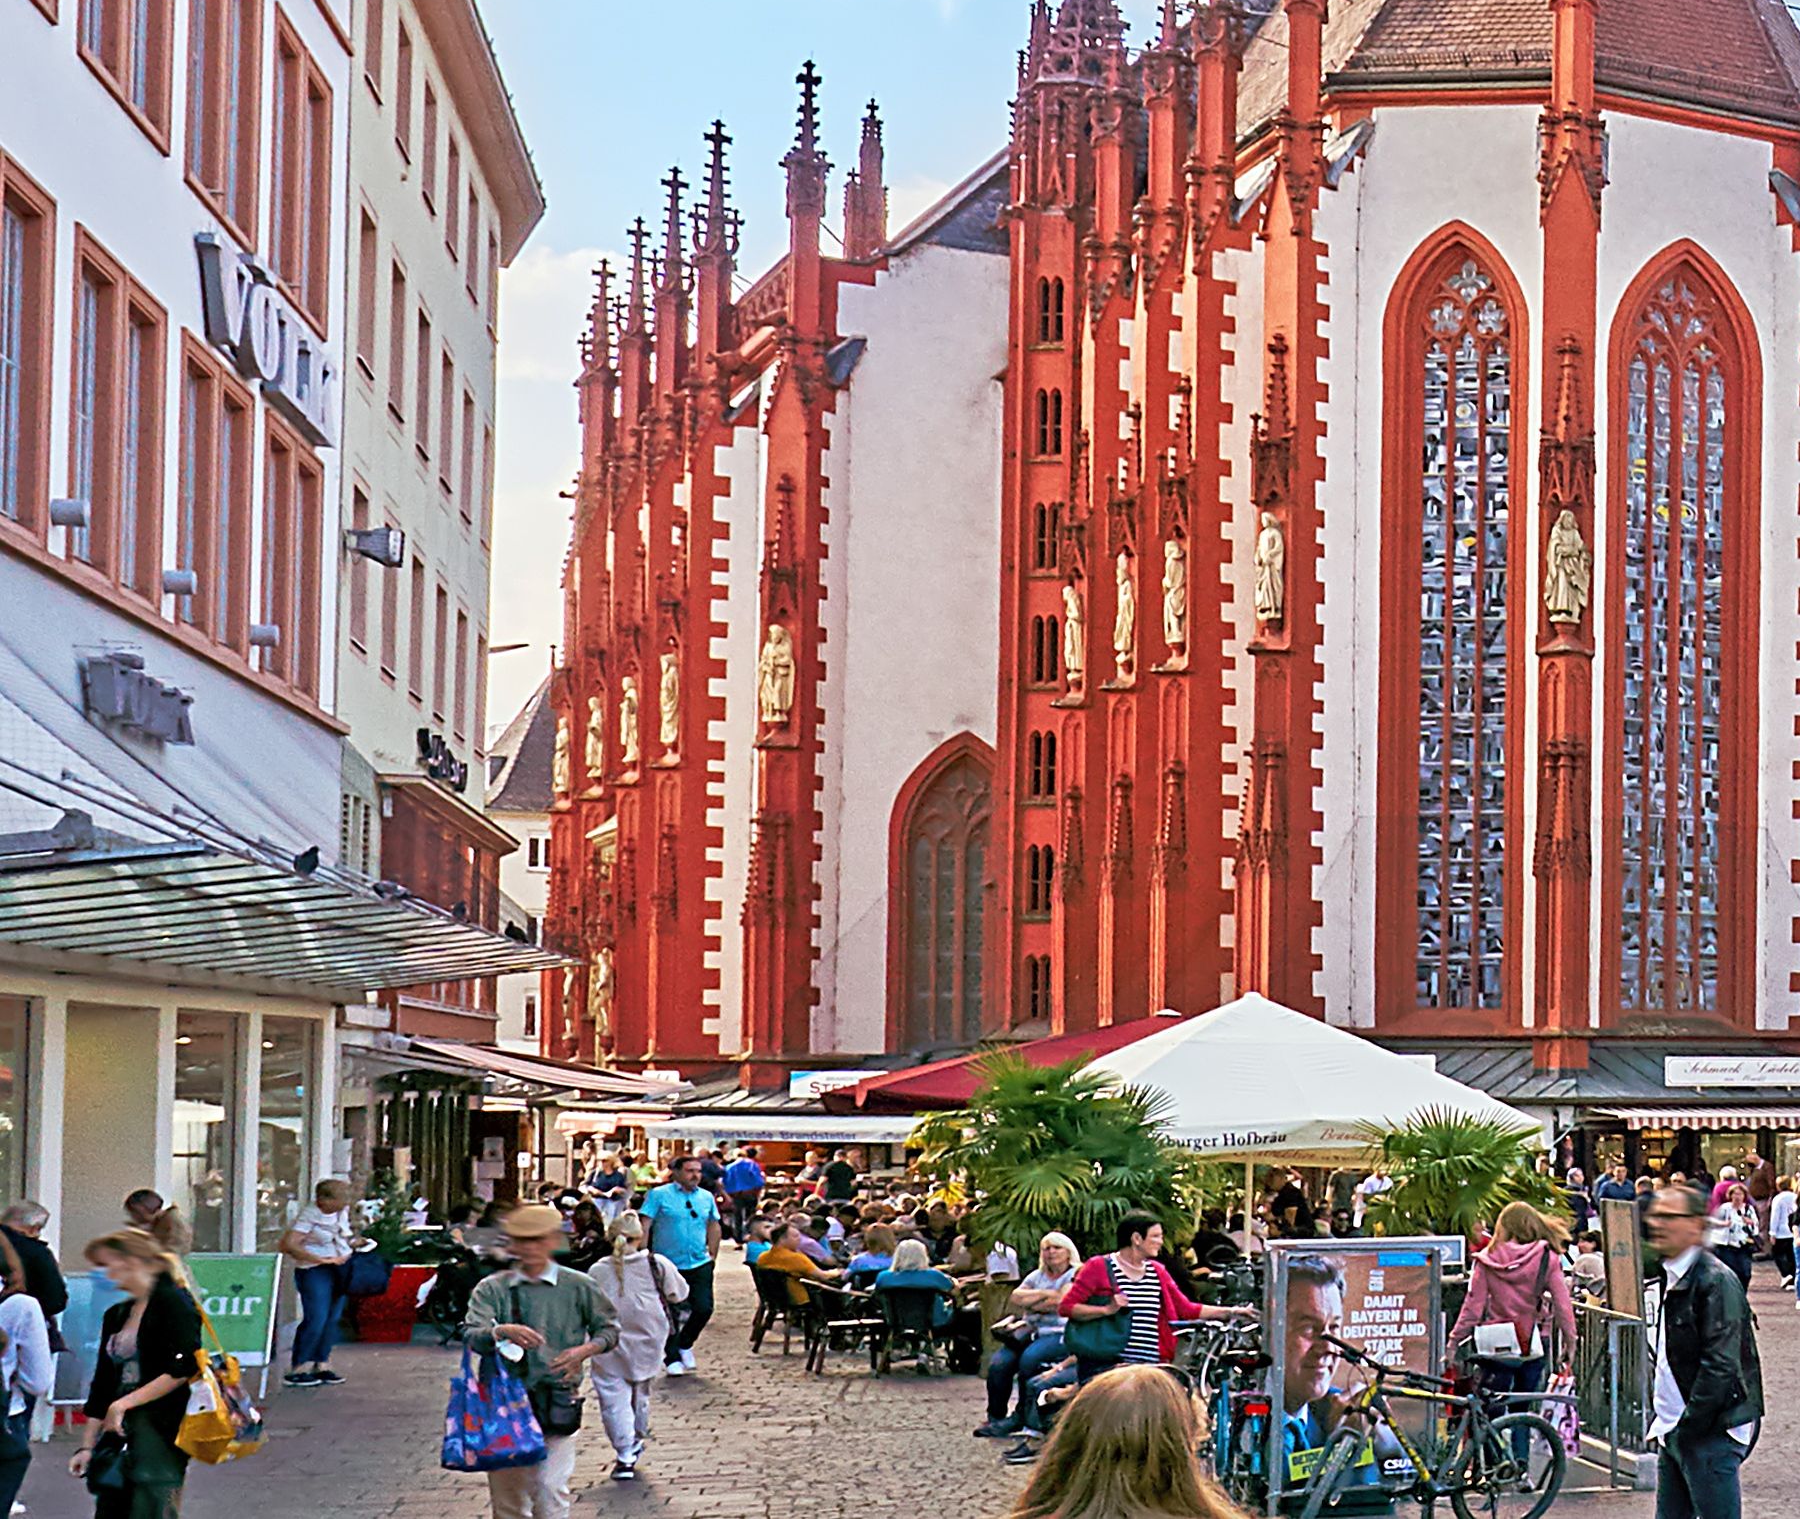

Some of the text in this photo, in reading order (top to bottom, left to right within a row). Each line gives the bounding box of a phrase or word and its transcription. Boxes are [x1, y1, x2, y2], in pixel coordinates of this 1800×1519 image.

[1166, 1132, 1287, 1152] burger Hofbräu
[199, 1286, 262, 1316] air
[1363, 1295, 1405, 1308] DAMIT
[1351, 1309, 1418, 1323] BAYERN IN
[1342, 1323, 1427, 1338] DEUTSCHLAND
[1363, 1338, 1404, 1352] STARK
